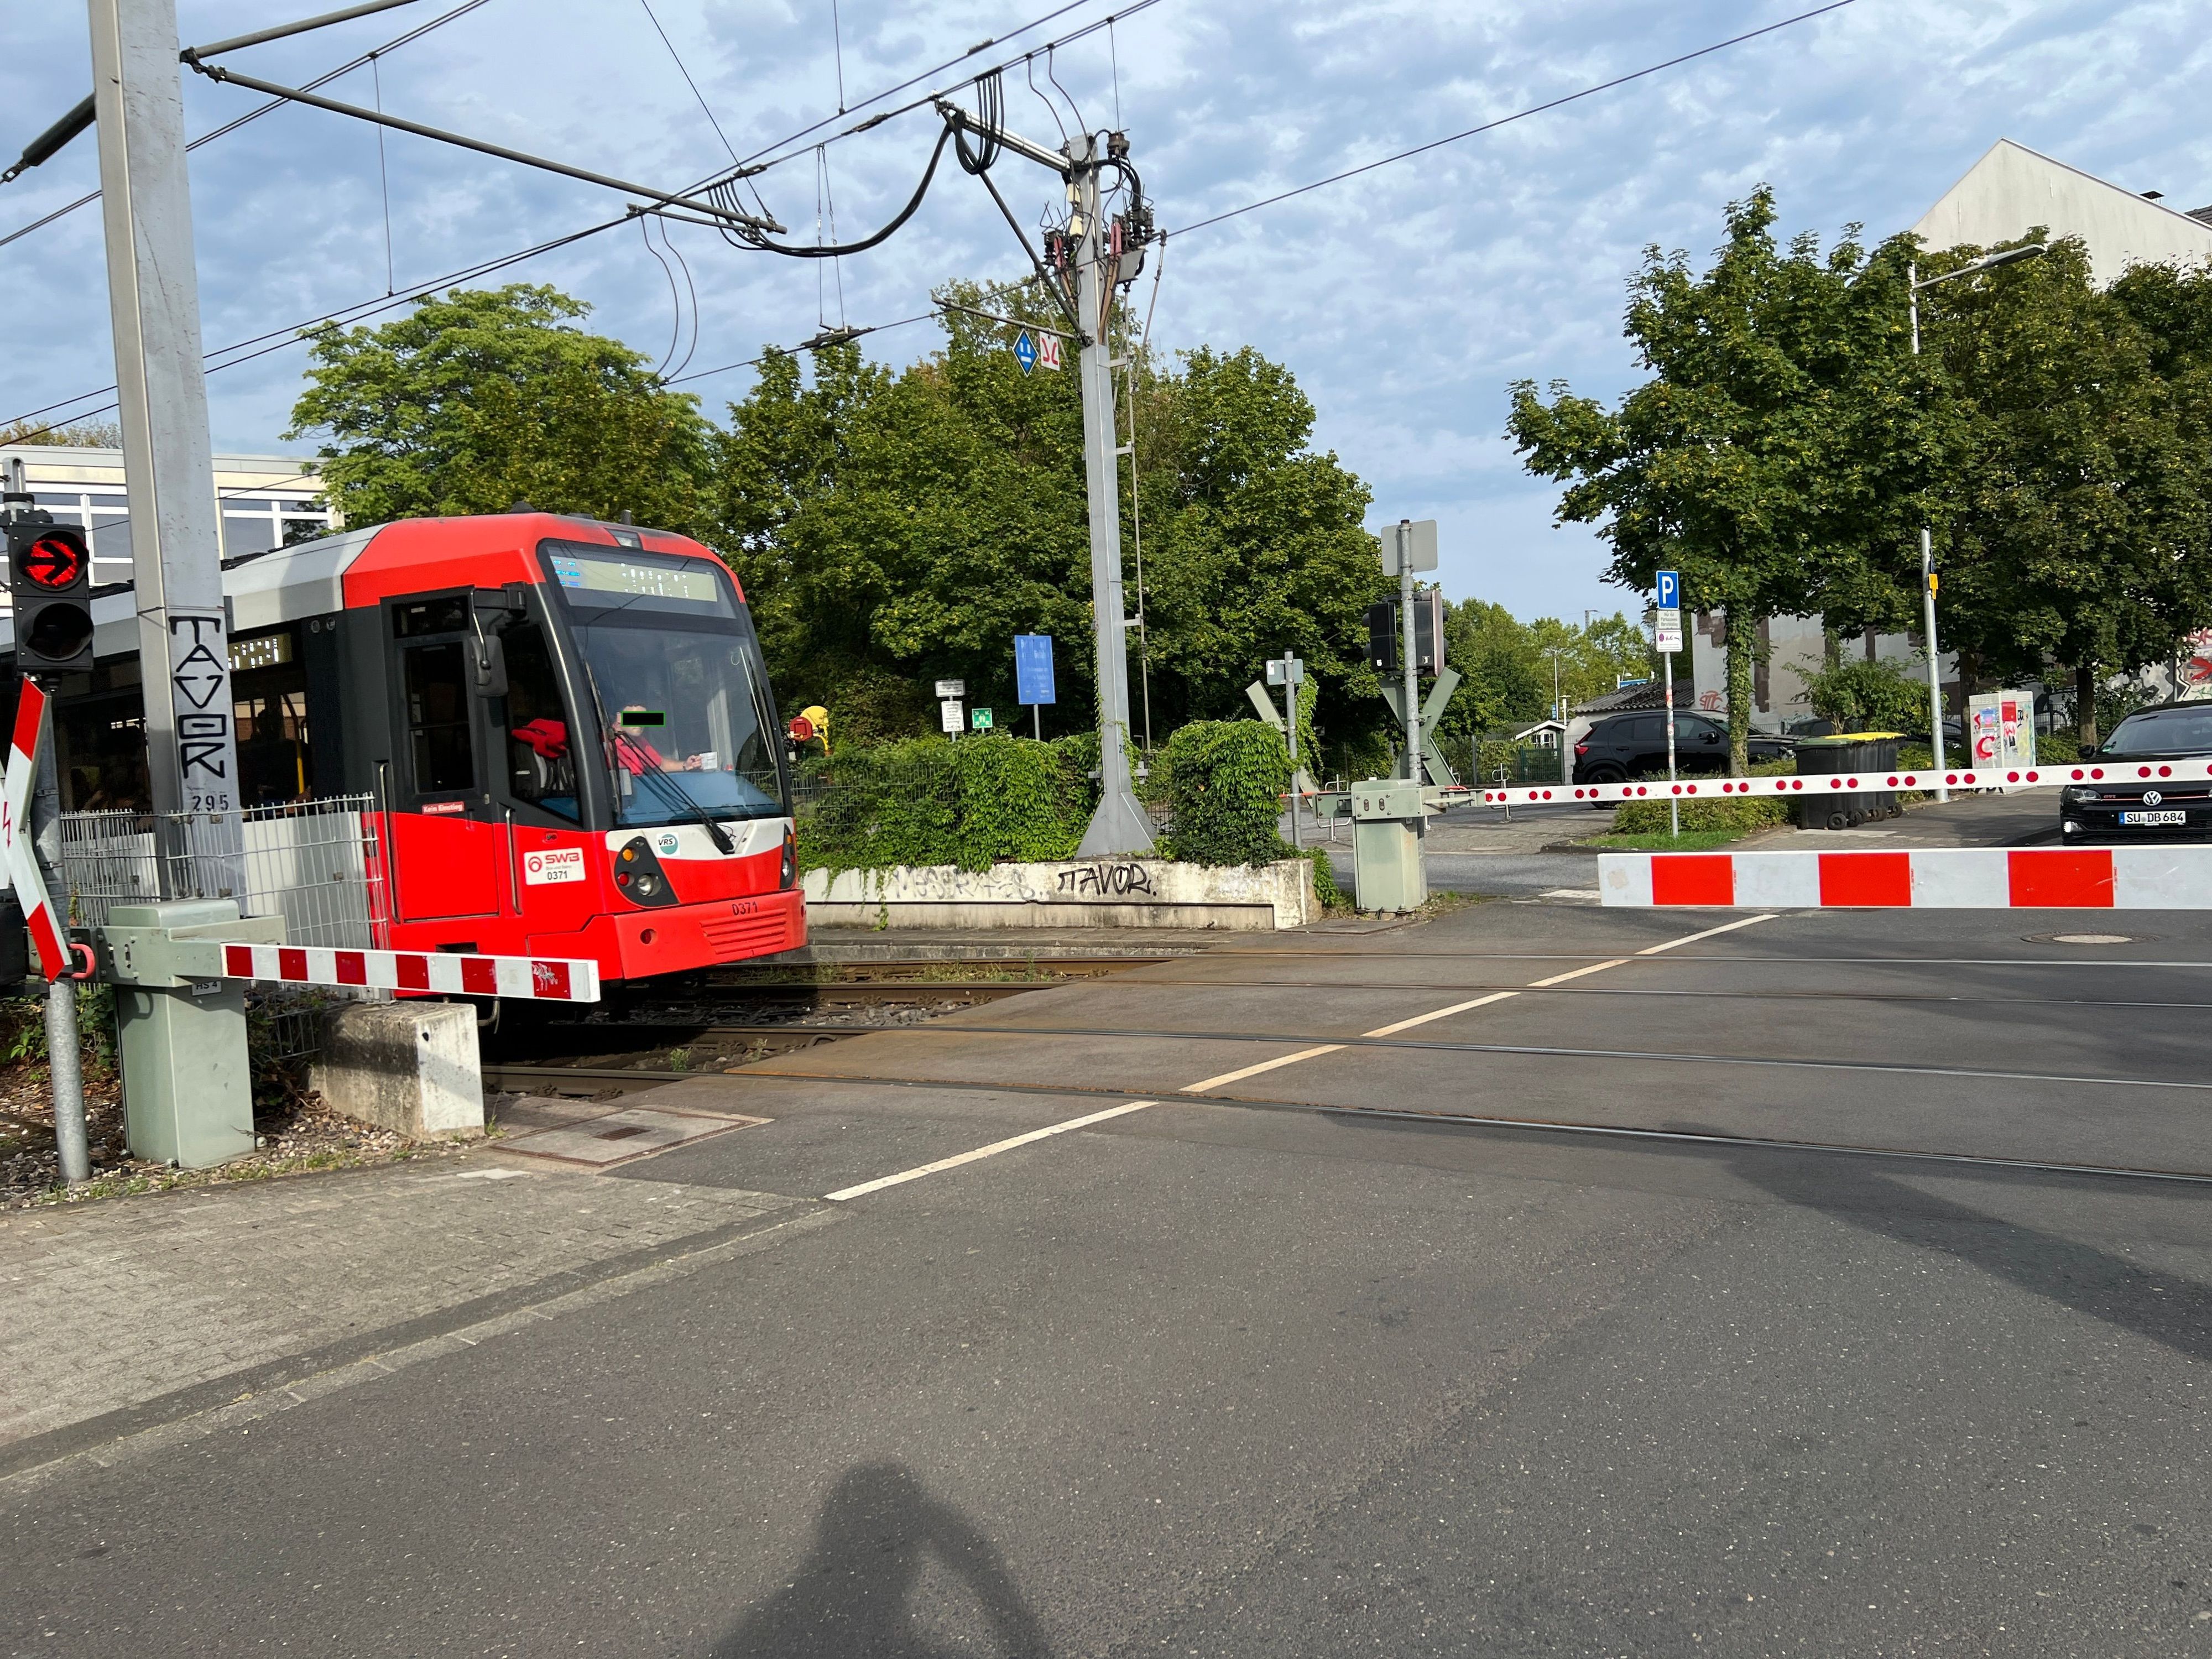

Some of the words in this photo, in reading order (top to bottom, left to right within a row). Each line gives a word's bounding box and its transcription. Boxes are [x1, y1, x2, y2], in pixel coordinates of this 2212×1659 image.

[1662, 576, 1674, 604] P
[168, 615, 227, 779] TAVOR
[192, 794, 229, 812] 295
[2127, 813, 2140, 822] SU
[2147, 813, 2161, 822] DB
[2163, 812, 2184, 821] 684
[545, 852, 580, 864] SWB
[547, 870, 568, 880] 0371
[732, 901, 758, 916] 0371
